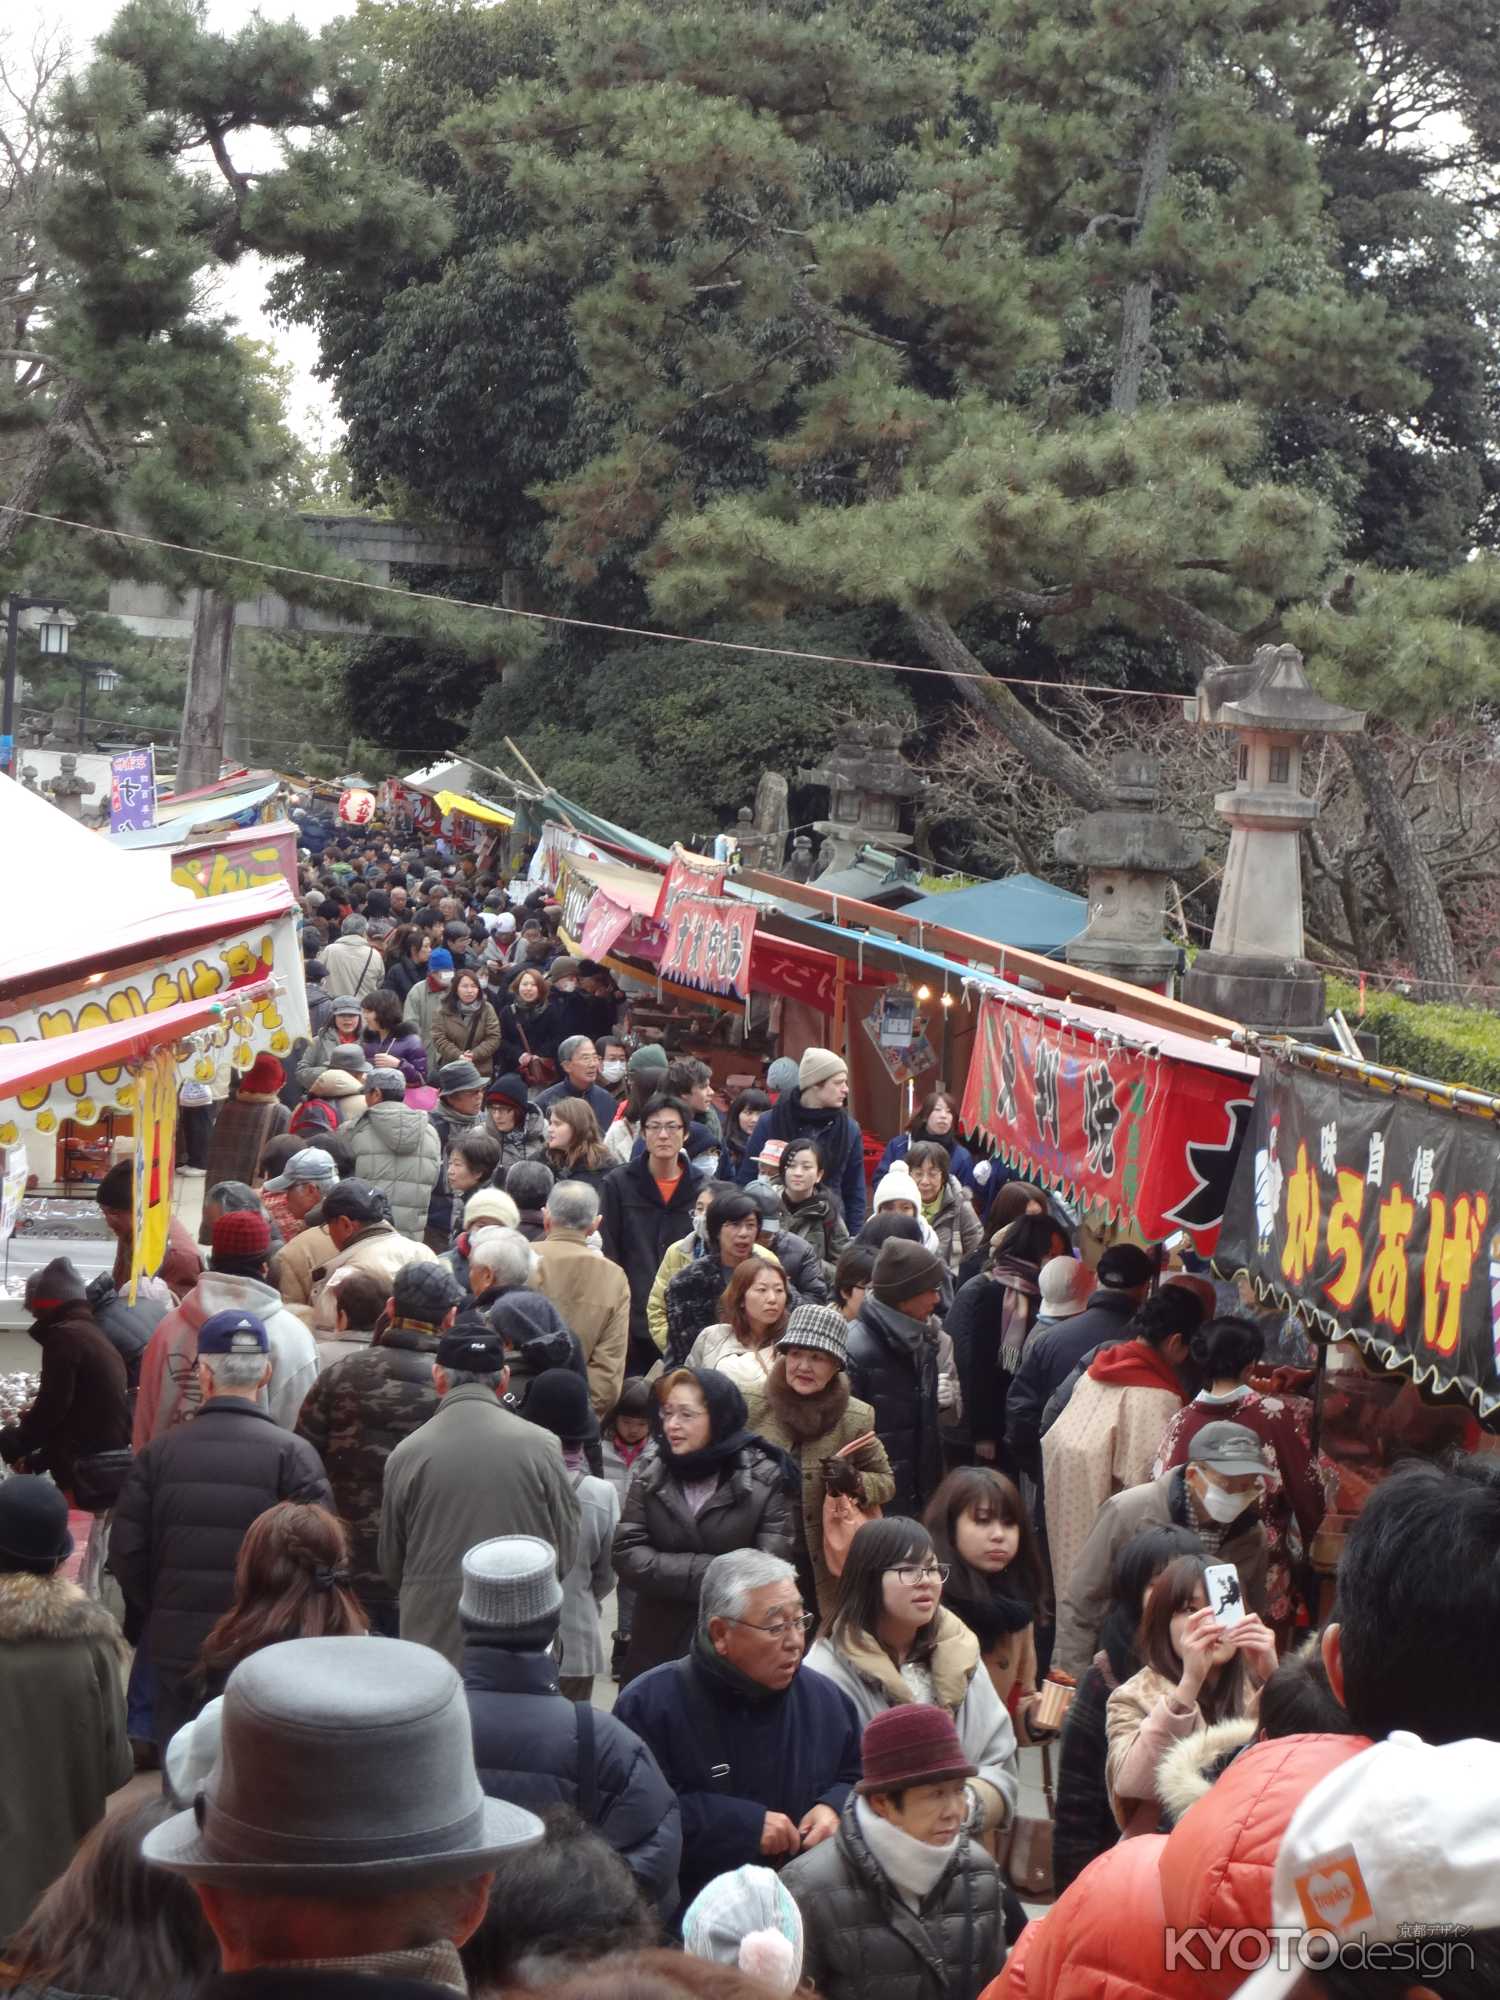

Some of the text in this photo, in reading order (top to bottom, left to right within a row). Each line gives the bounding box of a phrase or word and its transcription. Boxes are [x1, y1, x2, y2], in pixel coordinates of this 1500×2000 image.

[1320, 1120, 1436, 1209] 味自慢
[1281, 1139, 1488, 1357] からあげ
